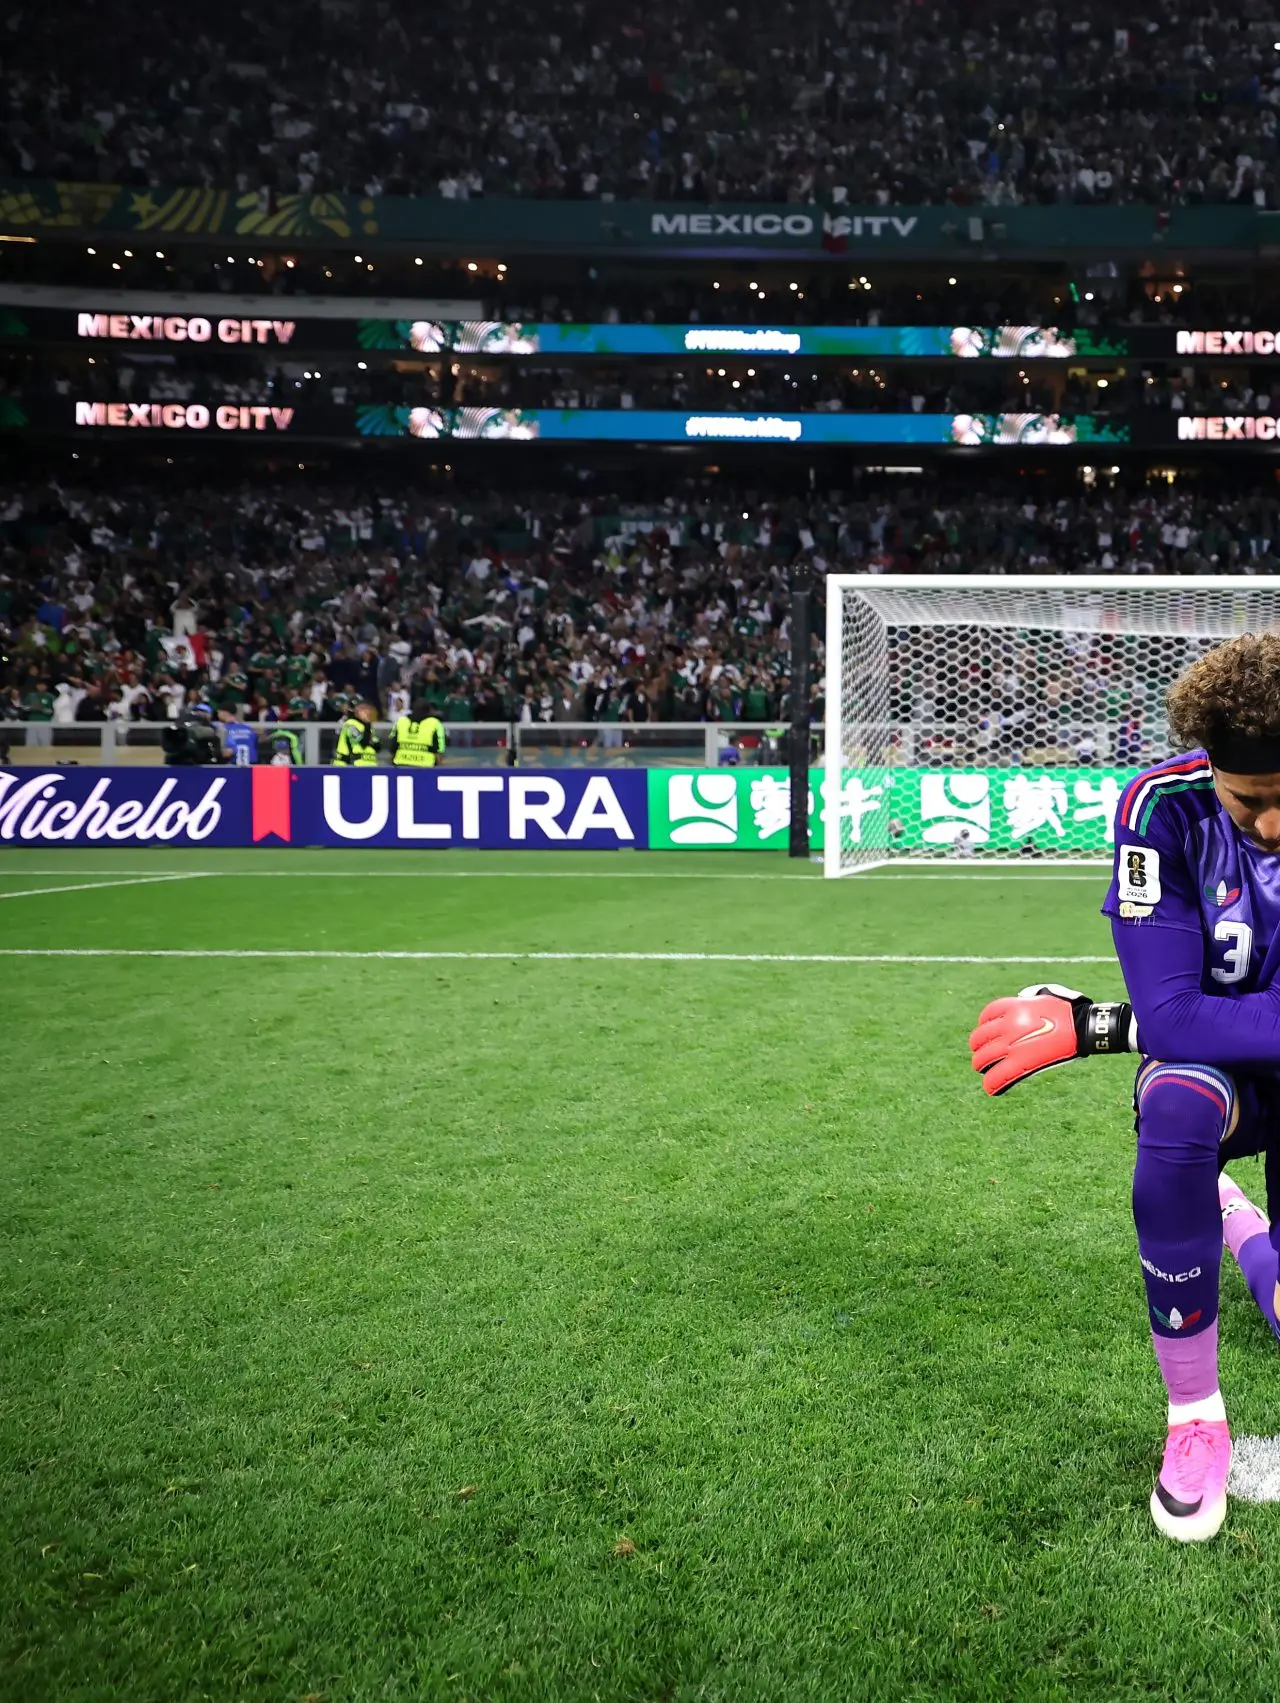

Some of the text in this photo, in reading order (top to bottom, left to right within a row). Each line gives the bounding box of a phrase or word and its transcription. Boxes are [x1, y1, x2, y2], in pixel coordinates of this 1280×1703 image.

[650, 213, 814, 236] MEXICO
[77, 312, 296, 344] MEXICO CITY
[75, 401, 294, 431] MEXICO CITY
[0, 771, 635, 841] Michelob ULTRA
[1095, 1006, 1111, 1034] OCH
